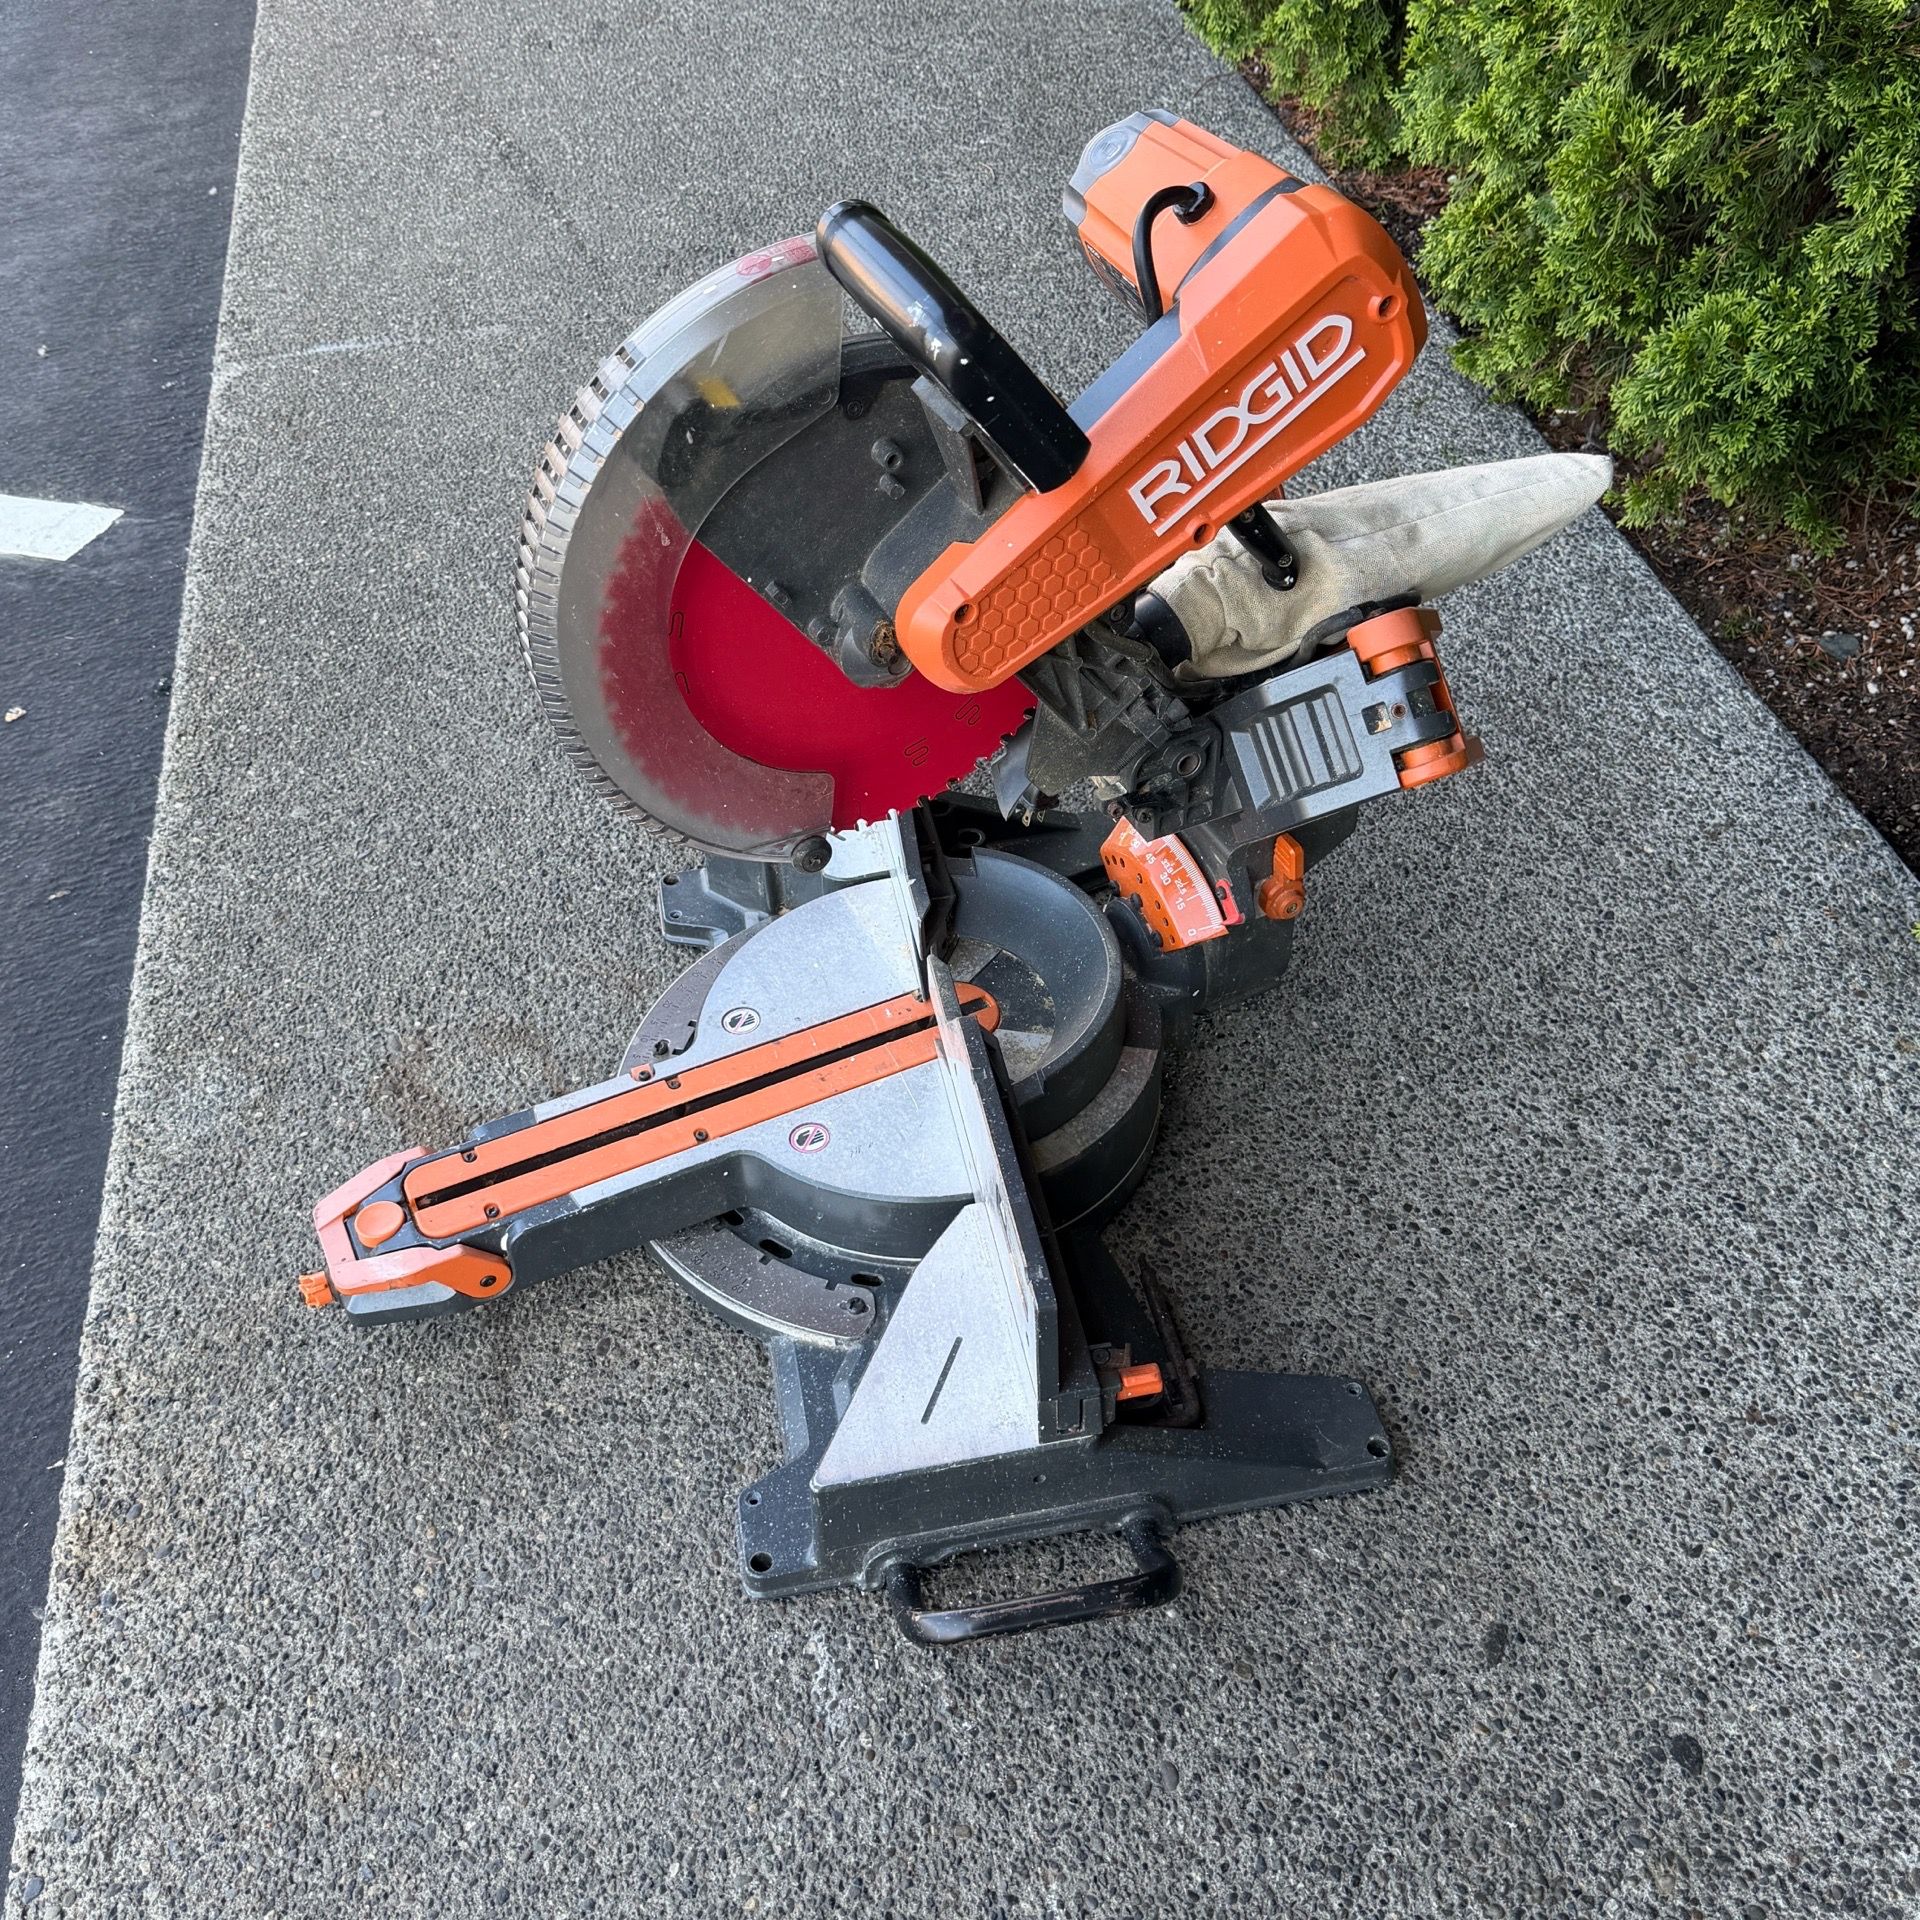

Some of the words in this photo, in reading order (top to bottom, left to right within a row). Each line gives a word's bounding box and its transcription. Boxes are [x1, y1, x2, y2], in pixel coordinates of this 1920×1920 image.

[1128, 313, 1353, 525] RIDGID
[1145, 853, 1156, 864] 45
[1160, 872, 1171, 886] 30
[1175, 897, 1186, 911] 15
[1187, 928, 1197, 937] 0
[731, 1284, 744, 1294] 60
